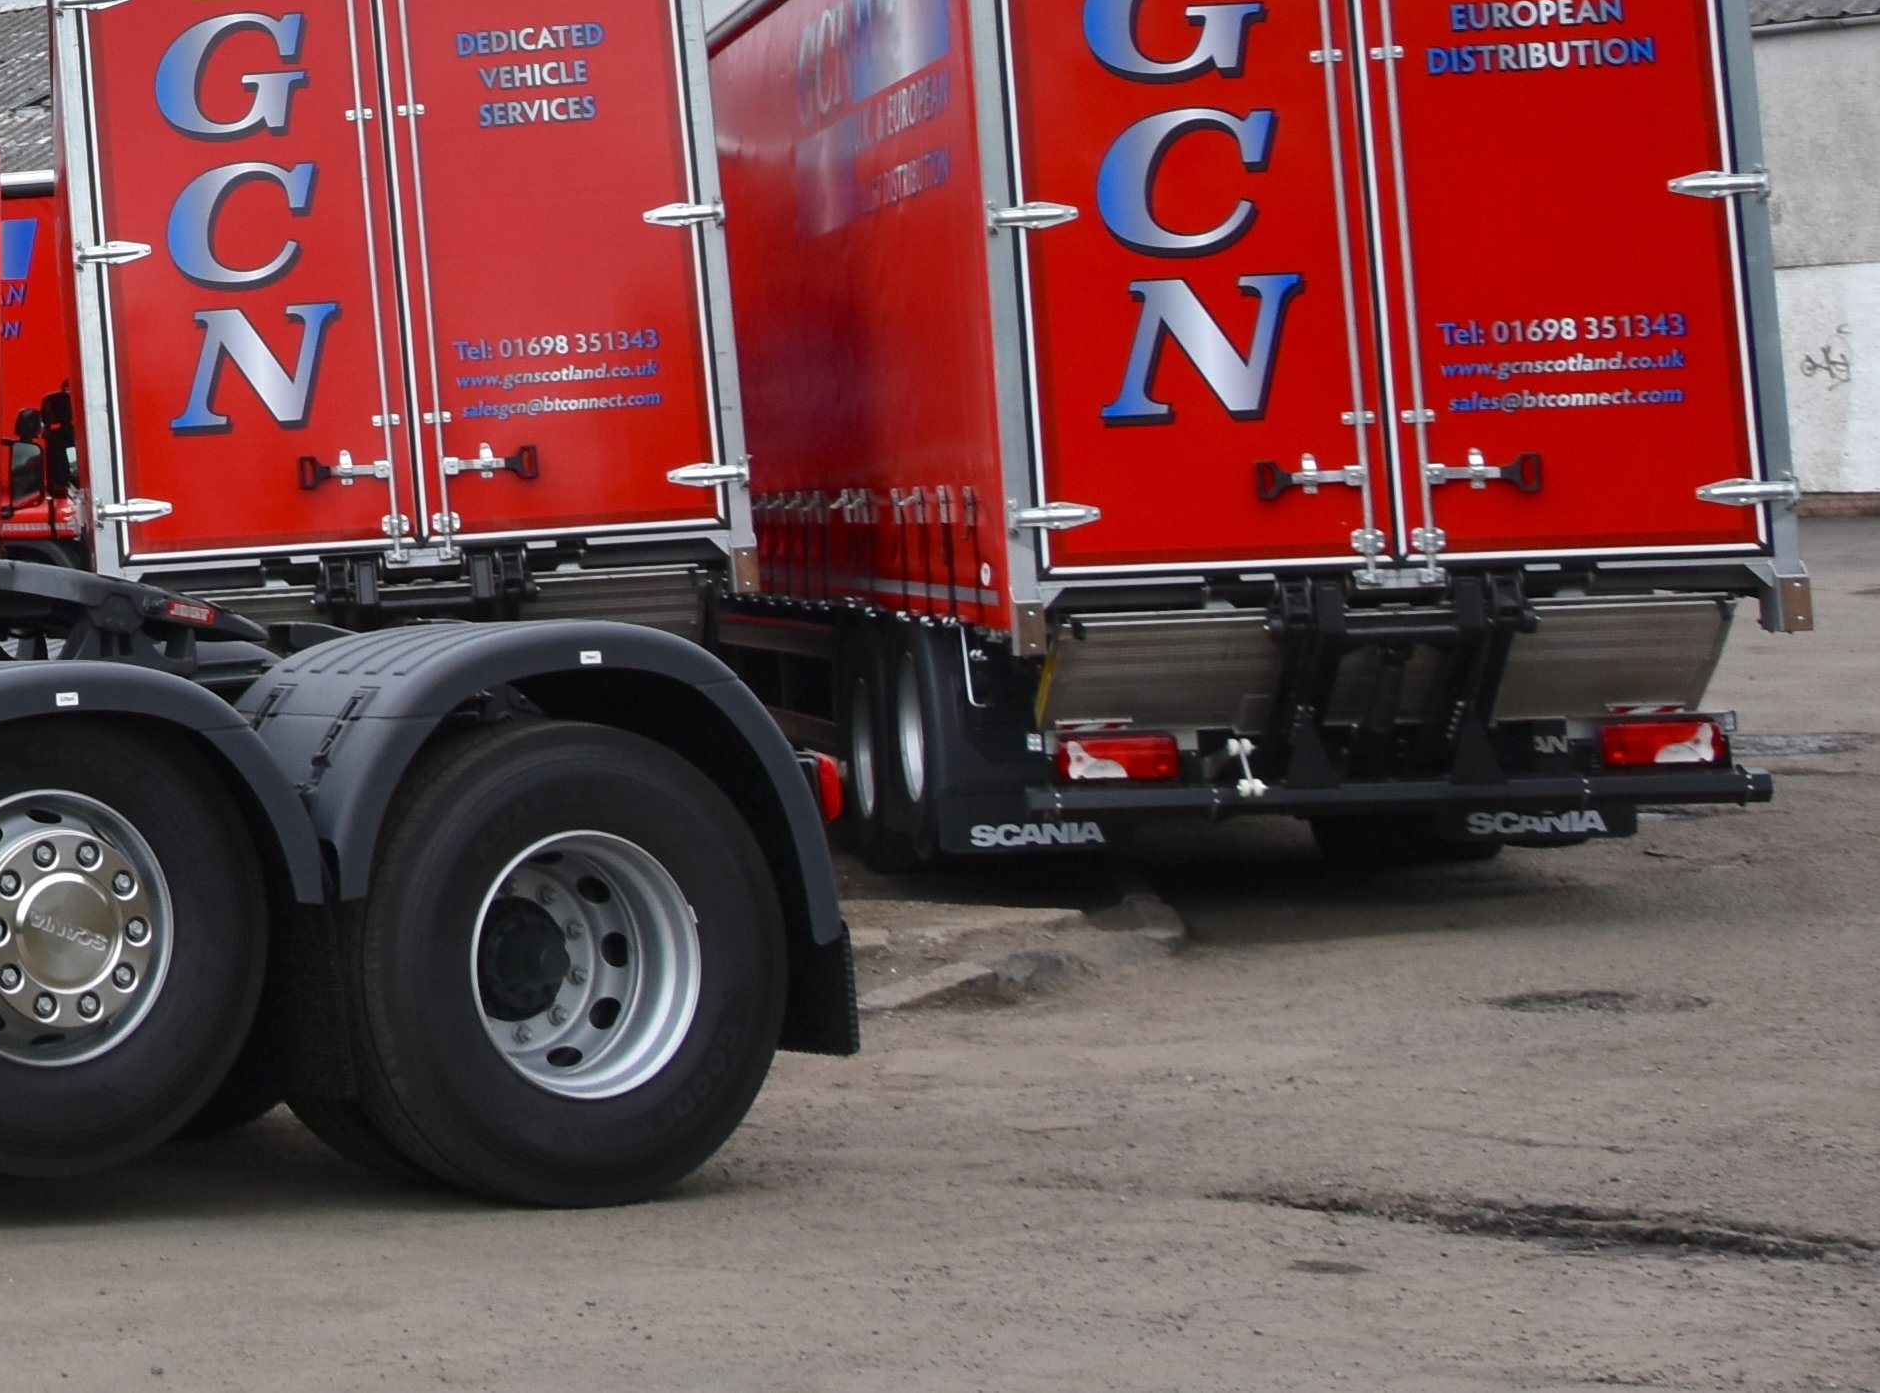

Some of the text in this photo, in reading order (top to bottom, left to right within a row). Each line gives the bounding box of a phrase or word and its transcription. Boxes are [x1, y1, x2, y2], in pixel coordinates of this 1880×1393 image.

[456, 22, 604, 57] DEDICATED
[1426, 37, 1656, 75] DISTRIBUTION
[479, 60, 588, 89] VEHICLE
[479, 95, 596, 127] SERVICES
[155, 12, 340, 436] GCN
[453, 328, 659, 361] Tel: 01698 351343
[1436, 313, 1687, 346] Tel: 01698 351343
[456, 359, 658, 390] www.gcnscotland.co.uk
[1441, 350, 1685, 380] www.gcnscotland.co.uk
[462, 392, 662, 420] salesgcn@btconnect.com
[1448, 388, 1685, 413] sales@btconnect.com
[970, 821, 1106, 847] SCANIA
[1466, 810, 1608, 835] SCANIA
